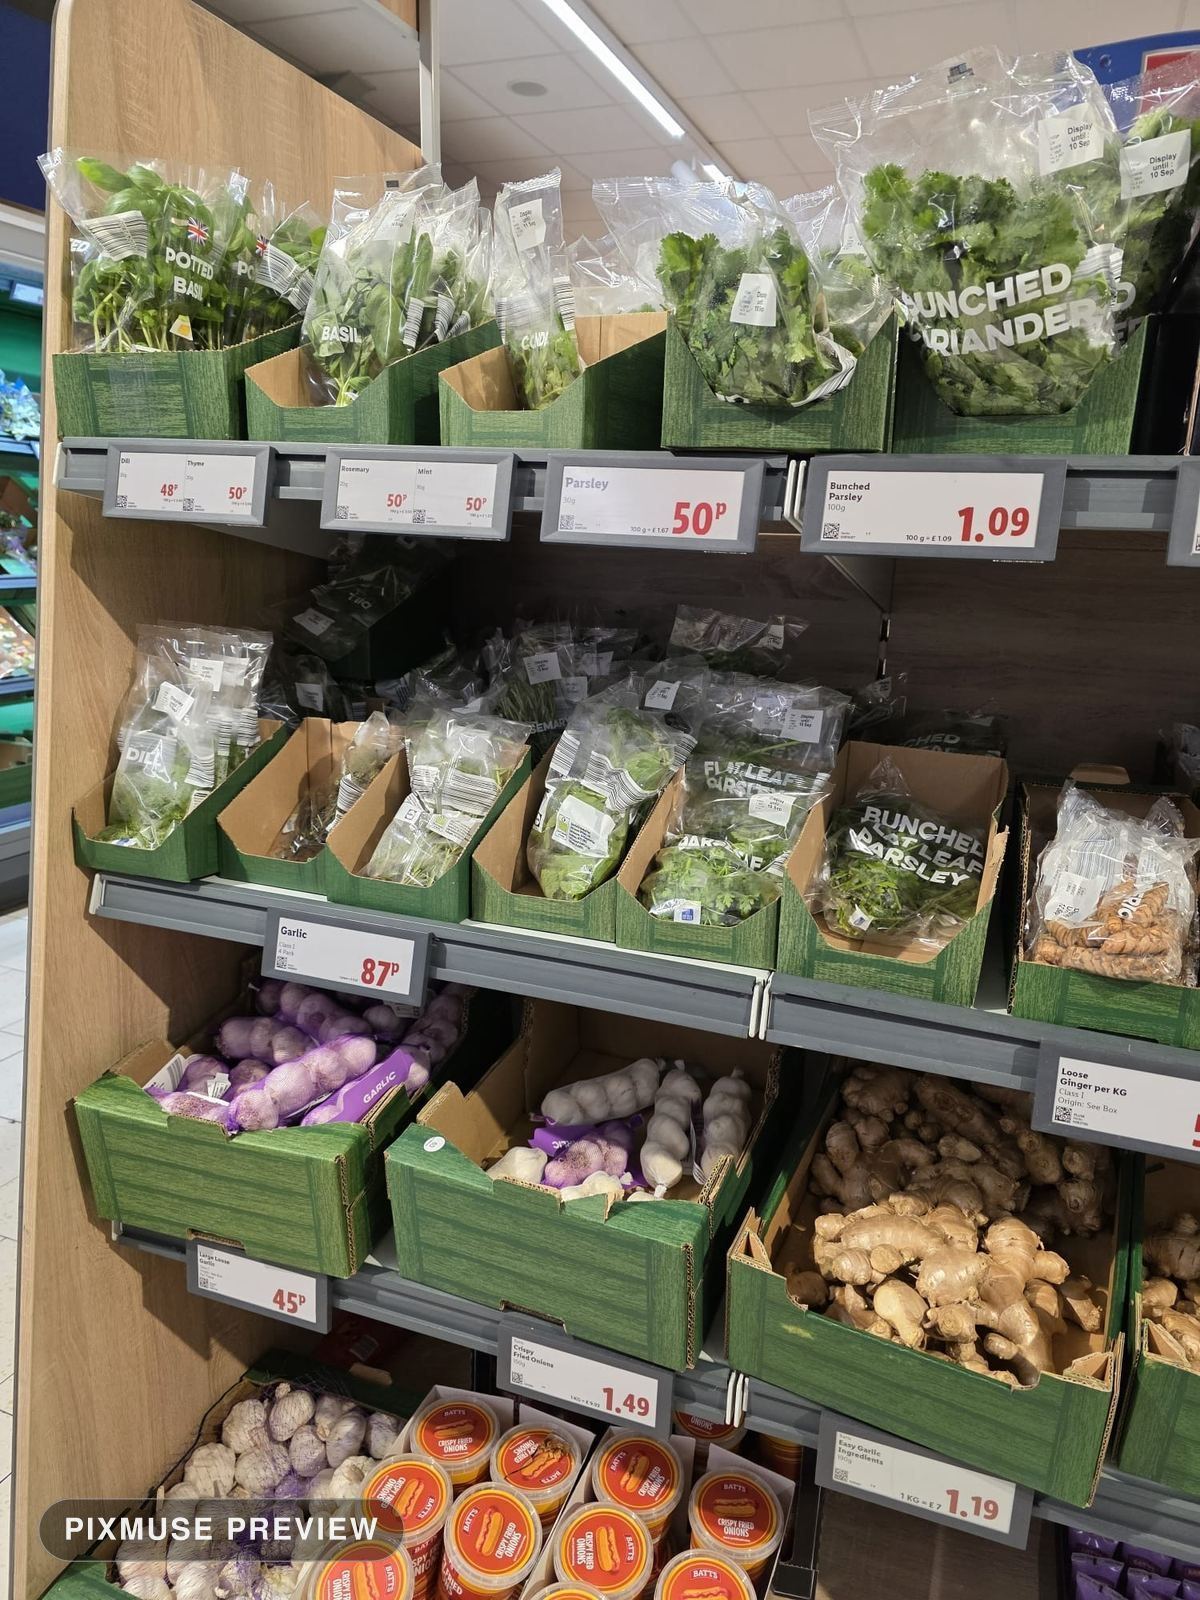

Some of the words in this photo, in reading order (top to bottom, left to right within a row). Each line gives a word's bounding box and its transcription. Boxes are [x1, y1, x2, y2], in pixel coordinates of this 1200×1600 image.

[1067, 123, 1093, 135] Display
[1069, 142, 1078, 150] 10
[1149, 153, 1177, 165] Display
[1152, 162, 1169, 171] until
[1150, 171, 1159, 179] 10
[1160, 169, 1175, 178] Sep
[165, 247, 214, 281] POTTED
[174, 275, 203, 301] BASIL
[321, 325, 363, 344] BASIL
[341, 466, 370, 474] Rosemary
[565, 477, 609, 491] Parsley
[830, 481, 871, 491] Bunched
[828, 492, 863, 503] Parsley
[827, 503, 846, 512] 100g
[657, 526, 669, 534] 1.67
[958, 506, 1030, 543] 1.09
[905, 534, 918, 542] 100
[919, 535, 925, 543] g
[745, 763, 799, 786] LEAF
[861, 806, 984, 858] BUNCHED
[873, 822, 918, 848] LAT
[919, 843, 983, 873] LEAF
[857, 827, 970, 886] PARSLEY
[280, 926, 308, 939] Garlic
[1061, 1068, 1089, 1079] Loose
[363, 1071, 397, 1105] GARLIC
[1059, 1088, 1079, 1098] Class
[1081, 1091, 1085, 1099] I
[1060, 1078, 1092, 1090] Ginger
[1094, 1085, 1110, 1093] per
[1113, 1087, 1127, 1096] KG
[1058, 1097, 1085, 1107] Origin:
[1086, 1102, 1101, 1110] See
[1103, 1105, 1118, 1113] Box
[513, 1344, 535, 1356] Crispy
[513, 1352, 530, 1361] Fried
[531, 1357, 554, 1368] Onions
[602, 1387, 650, 1417] 1.49
[691, 1415, 713, 1431] ONIONS
[438, 1439, 457, 1448] CRISPY
[457, 1437, 473, 1446] FRIED
[443, 1443, 468, 1453] ONIONS
[838, 1440, 857, 1450] Easy
[857, 1445, 881, 1457] Garlic
[610, 1451, 627, 1471] BATTS
[838, 1447, 884, 1465] Ingredients
[638, 1478, 652, 1497] CRISPY
[648, 1465, 661, 1482] FRIED
[648, 1474, 665, 1498] ONIONS
[723, 1483, 747, 1493] BATTS
[906, 1494, 919, 1504] KG
[946, 1489, 999, 1521] 1.19
[417, 1497, 435, 1519] BATTS
[463, 1507, 478, 1532] BATTS
[717, 1518, 737, 1529] CRISPY
[737, 1520, 755, 1531] FRIED
[495, 1537, 509, 1559] CRISPY
[505, 1522, 517, 1541] FRIED
[723, 1526, 750, 1538] ONIONS
[505, 1531, 522, 1558] ONIONS
[585, 1531, 593, 1552] CRISPY
[626, 1536, 634, 1561] BATTS
[576, 1537, 586, 1565] ONIONS
[585, 1553, 593, 1570] FRIED
[385, 1565, 394, 1593] BATTS
[692, 1570, 718, 1580] BATTS
[333, 1579, 342, 1600] ONIO
